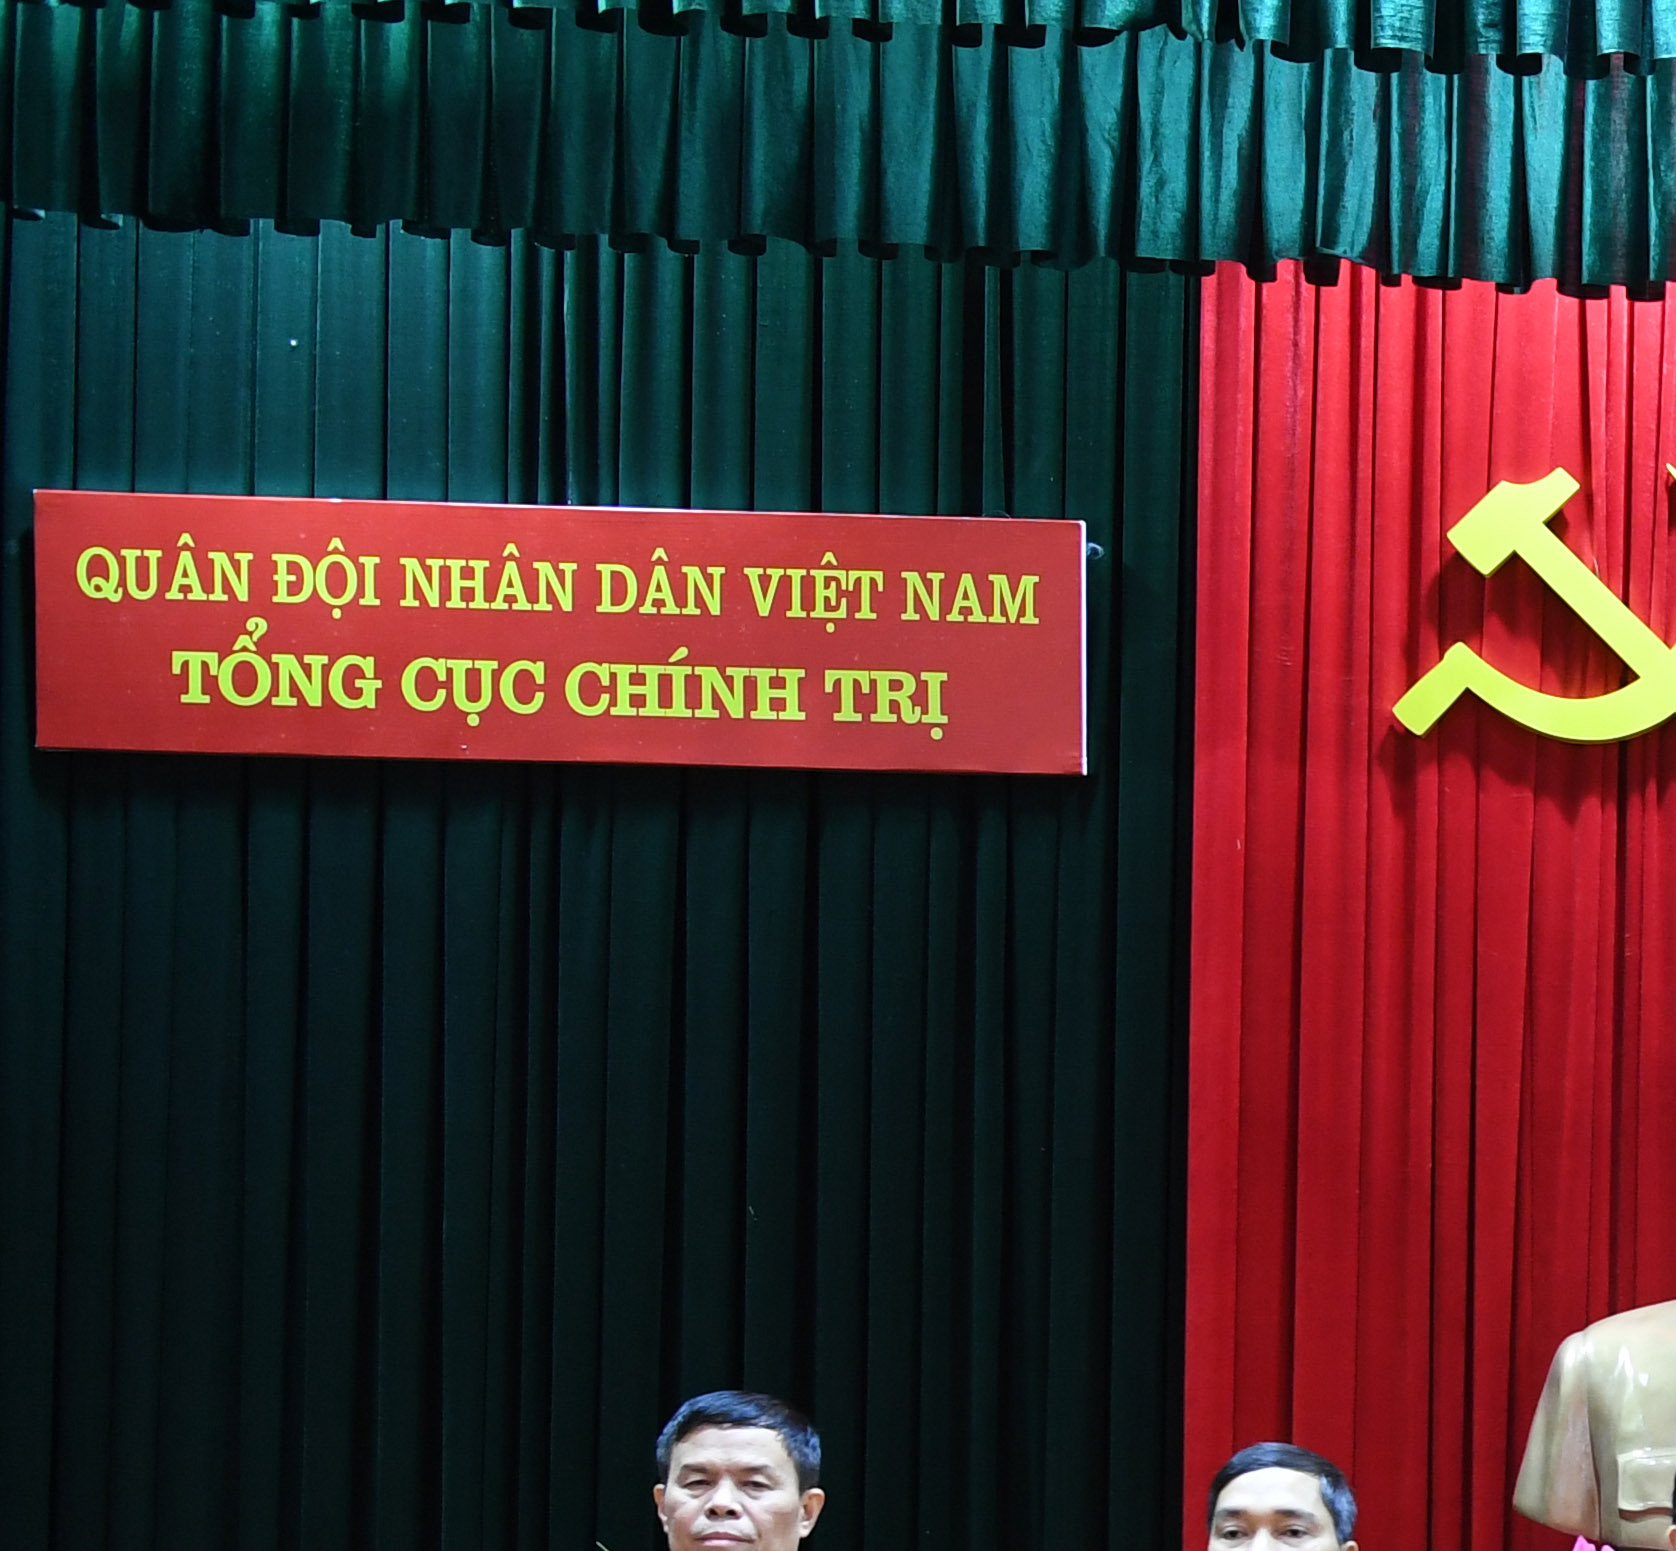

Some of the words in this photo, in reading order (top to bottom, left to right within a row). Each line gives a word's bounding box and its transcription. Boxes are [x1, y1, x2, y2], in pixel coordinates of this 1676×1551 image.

[76, 532, 254, 603] QUÂN
[271, 536, 381, 620] ĐỘI
[399, 542, 578, 612] NHÂN
[595, 547, 726, 616] DÂN
[743, 551, 884, 633] VIỆT
[900, 571, 1040, 625] NAM
[171, 616, 383, 710] TỔNG
[400, 656, 545, 727] CỤC
[564, 646, 807, 721] CHÍNH
[824, 669, 949, 740] TRỊ
